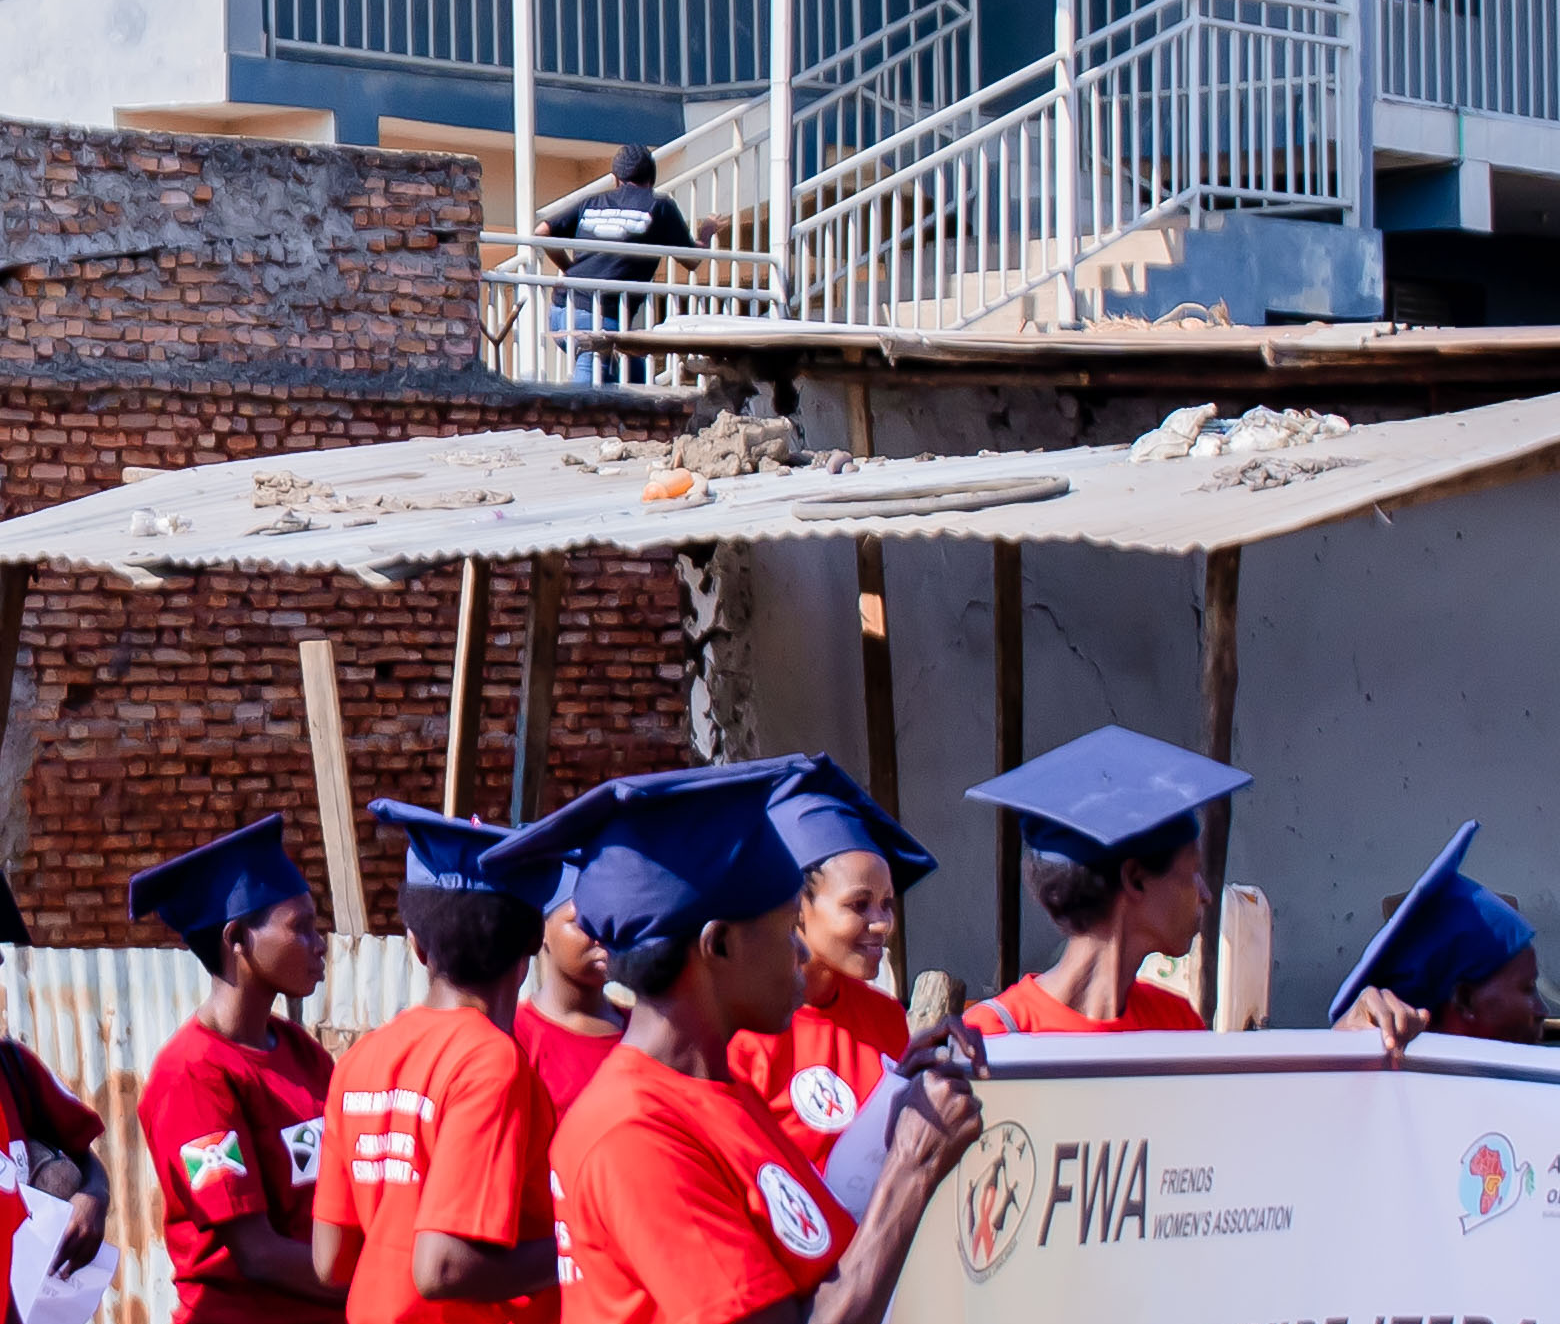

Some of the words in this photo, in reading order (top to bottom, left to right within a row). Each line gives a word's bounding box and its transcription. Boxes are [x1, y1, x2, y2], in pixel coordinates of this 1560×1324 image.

[1038, 1138, 1149, 1247] FWA
[1160, 1166, 1214, 1195] FRIENDS
[1153, 1211, 1212, 1240] WOMEN'S
[1212, 1205, 1294, 1235] ASSOCIATION
